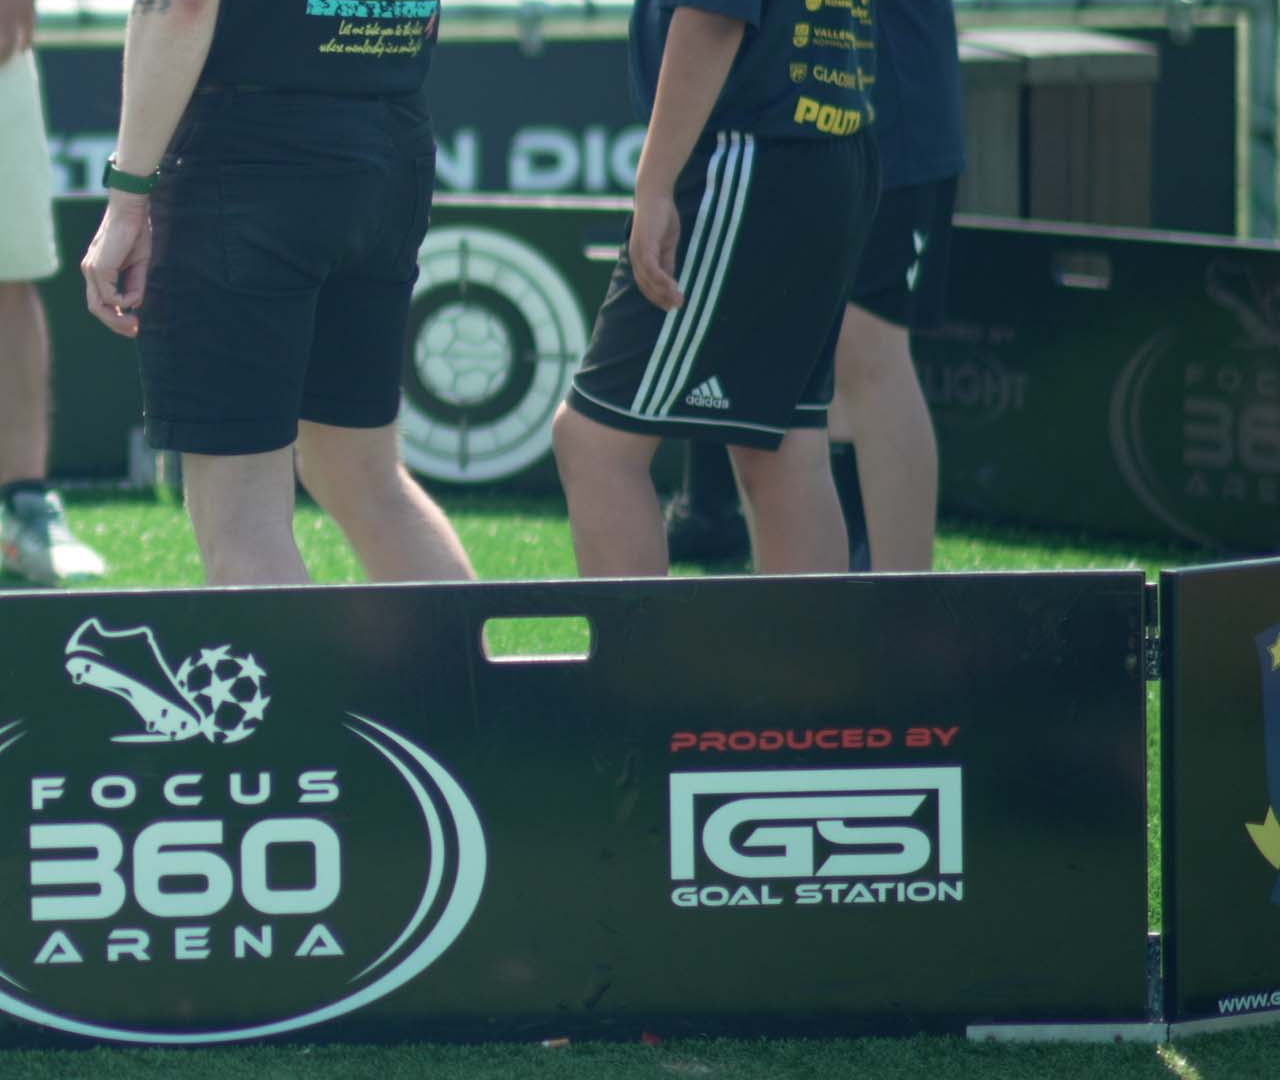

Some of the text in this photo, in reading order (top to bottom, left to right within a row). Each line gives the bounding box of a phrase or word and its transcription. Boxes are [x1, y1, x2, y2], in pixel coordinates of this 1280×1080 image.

[669, 725, 961, 754] PRODUCED BY
[31, 770, 341, 811] FOCUS
[28, 816, 342, 922] 360
[671, 879, 965, 908] GOAL STATION
[33, 923, 345, 965] ARENA
